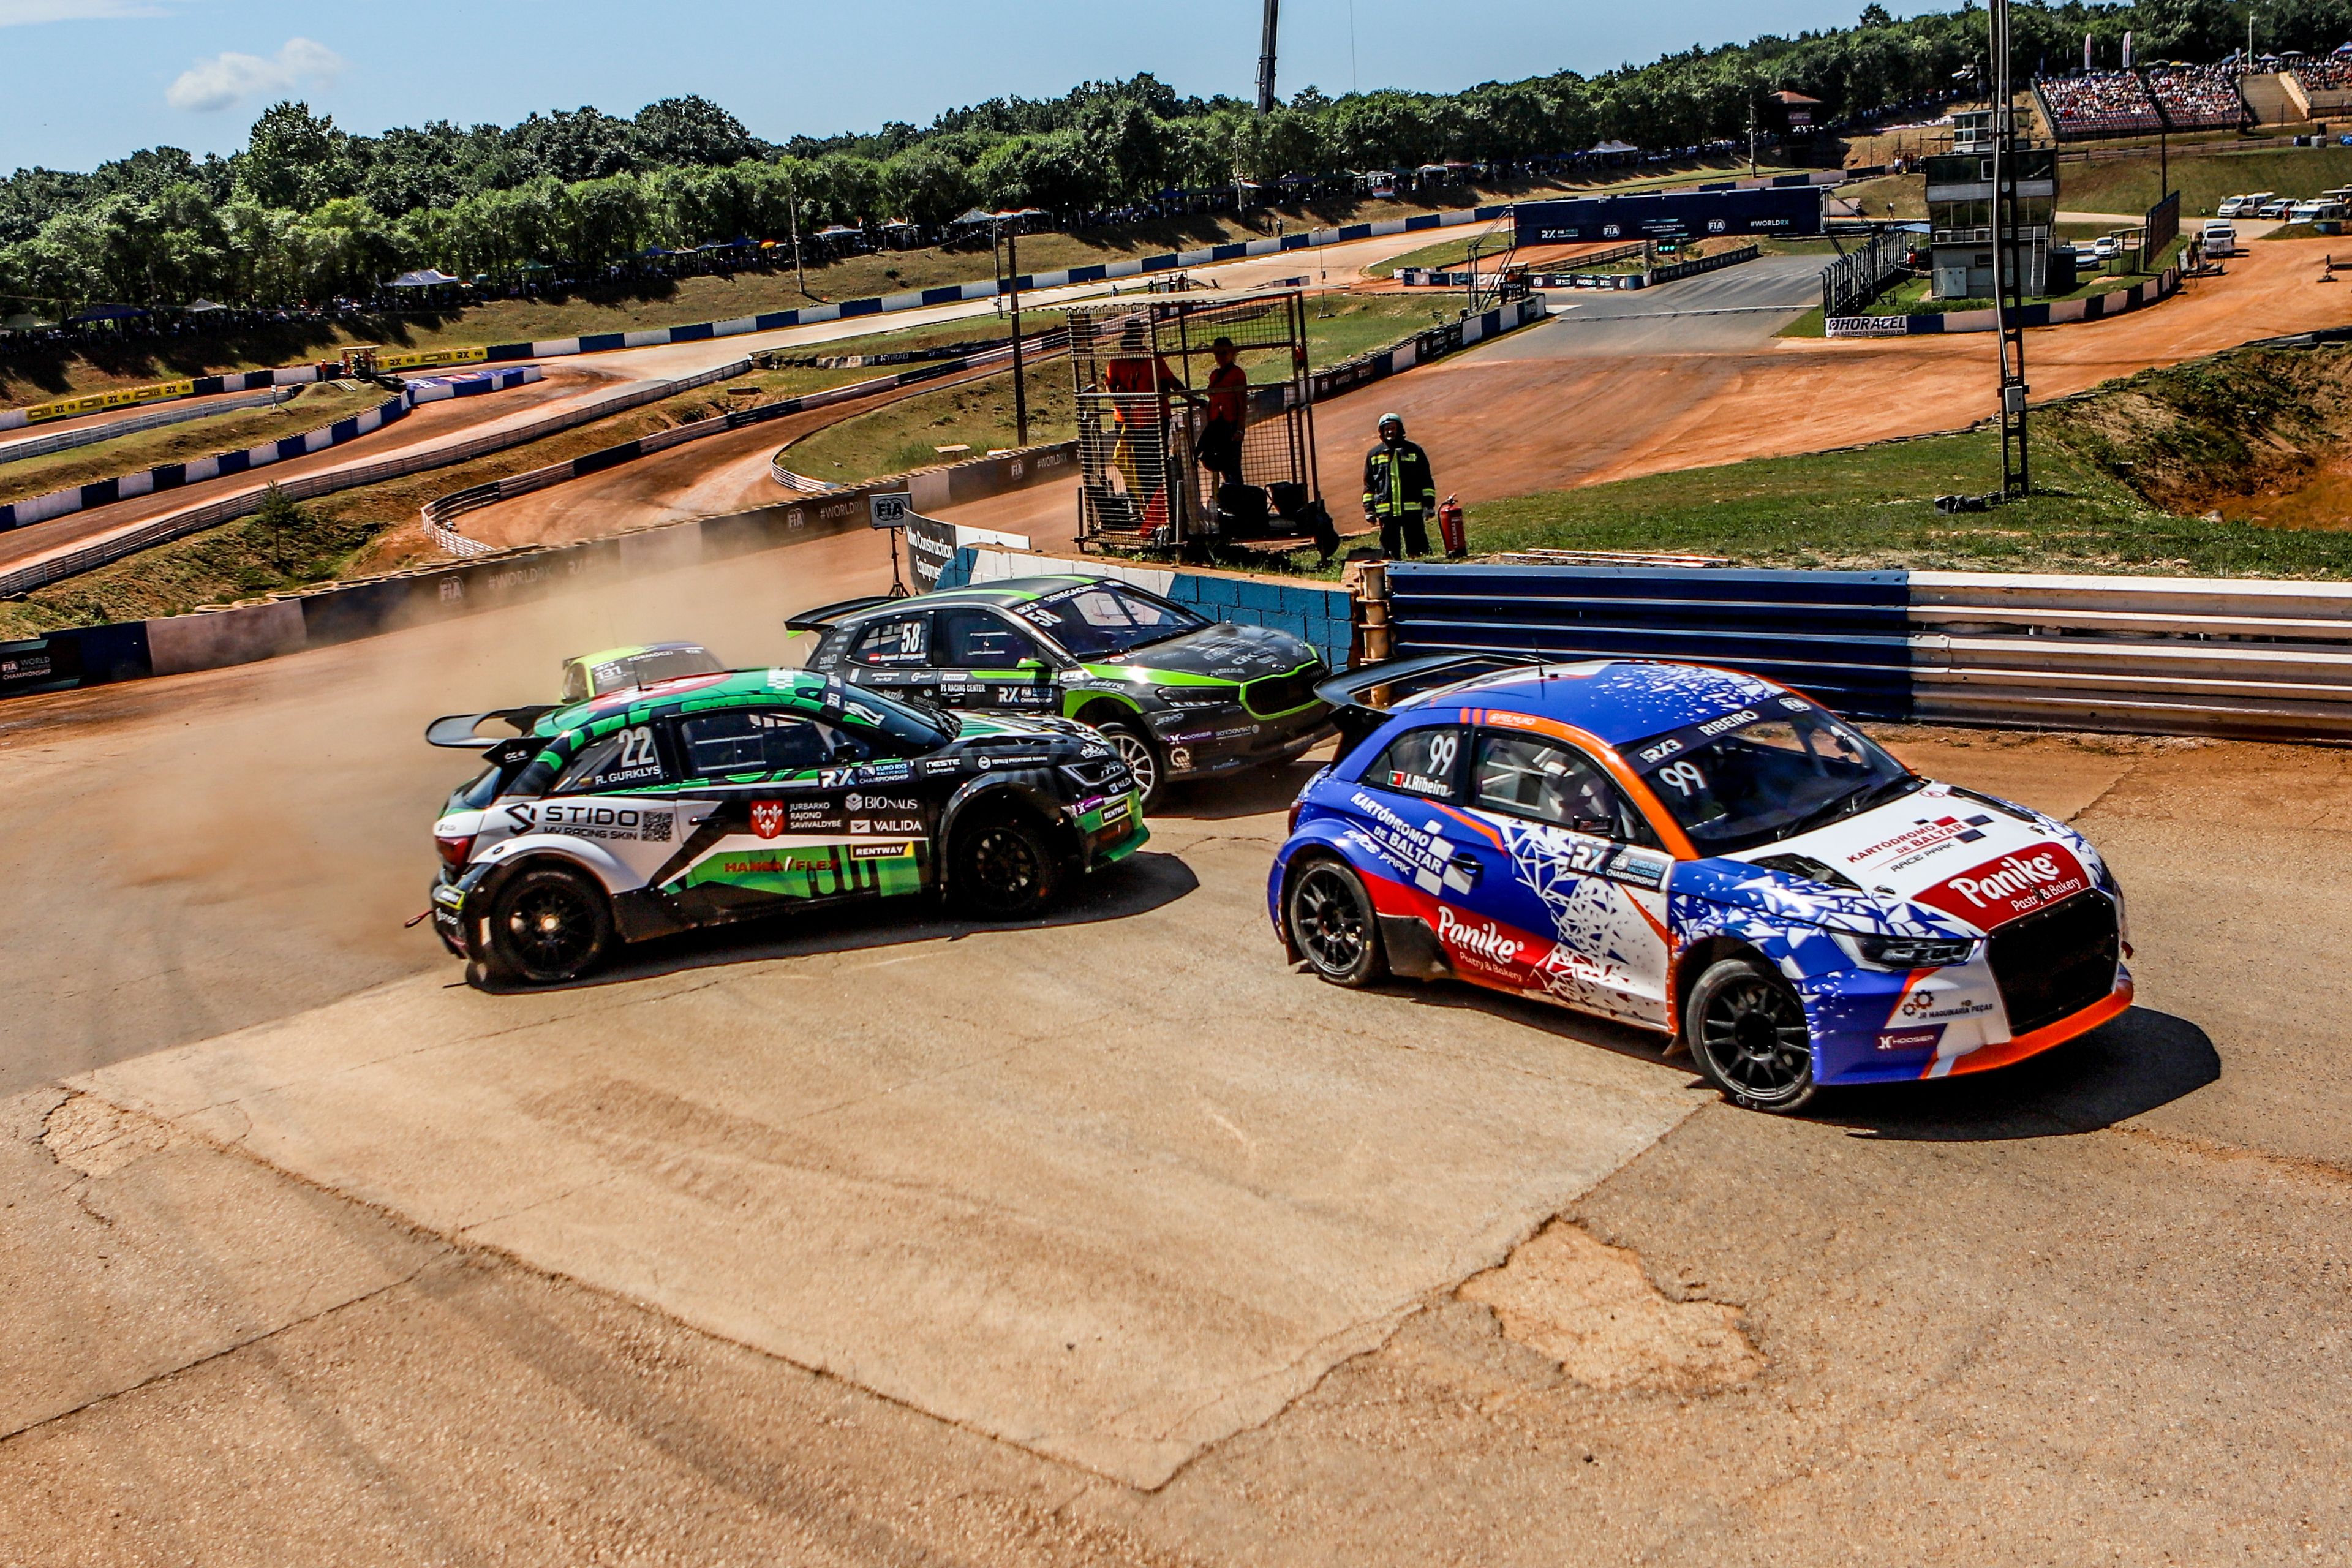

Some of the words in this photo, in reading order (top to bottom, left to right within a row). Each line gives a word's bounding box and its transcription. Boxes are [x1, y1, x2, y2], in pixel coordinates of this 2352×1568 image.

[1604, 227, 1619, 236] FIA
[1708, 221, 1723, 230] FIA
[1542, 230, 1556, 238] RX
[165, 385, 178, 394] RX
[107, 395, 118, 404] RX
[54, 404, 66, 413] RX
[1037, 453, 1068, 469] #WORLDRX
[1011, 464, 1023, 477] FIA
[820, 501, 864, 520] #WORLDRX
[876, 503, 905, 518] FIA
[788, 512, 804, 529] FIA
[916, 530, 954, 559] Construction
[488, 565, 552, 589] #WORLDRX
[440, 582, 461, 601] FIA
[1025, 608, 1063, 628] 58
[900, 622, 921, 654] 58
[2, 661, 18, 673] FIA
[20, 657, 50, 666] WORLD
[3, 668, 51, 680] CHAMPIONSHIP
[595, 665, 622, 680] 131
[940, 684, 947, 693] PS
[948, 684, 966, 693] RACING
[966, 684, 986, 693] CENTER
[998, 687, 1019, 703] RX
[1783, 699, 1809, 711] FIA
[1698, 710, 1759, 736] RIBEIRO
[1180, 731, 1212, 741] HOOSIER
[618, 726, 655, 768] 22
[1645, 739, 1684, 762] RX3
[925, 758, 961, 768] NESTE
[1427, 734, 1457, 777] 99
[595, 775, 607, 785] R.
[608, 766, 662, 783] GURKLYS
[821, 768, 856, 788] RX
[859, 774, 909, 785] CHAMPIONSHIP
[1659, 761, 1706, 797] 99
[1402, 774, 1449, 797] J.Ribeiro
[790, 802, 831, 812] JURBARKO
[1104, 804, 1127, 820] RENTWAY
[545, 806, 639, 827] STIDO
[790, 811, 822, 820] RAJONO
[1350, 791, 1431, 847] KARTÓDROMO
[565, 827, 608, 838] RACING
[609, 830, 638, 840] SKIN
[873, 820, 922, 832] VAILIDA
[1847, 824, 1937, 863] KARTÓDROMO
[1895, 845, 1912, 854] DE
[1910, 823, 1967, 847] BALTAR
[856, 846, 903, 856] RENTWAY
[1343, 829, 1380, 854] RACE
[1378, 851, 1411, 876] PARK
[1373, 825, 1386, 840] DE
[1388, 833, 1444, 874] BALTAR
[1890, 854, 1924, 873] RACE
[1923, 842, 1956, 858] PARK
[1627, 865, 1660, 878] RALLYCROSS
[1629, 858, 1649, 869] EURO
[1606, 869, 1658, 887] CHAMPIONSHIP
[1948, 856, 2060, 908] Panike
[2040, 888, 2052, 900] &
[2047, 877, 2082, 897] Bakery
[1438, 905, 1517, 965] Panike
[1459, 951, 1484, 970] Pastry
[1485, 960, 1493, 971] &
[1493, 963, 1523, 982] Bakery
[1971, 1003, 1993, 1013] PEÇAS
[1893, 1035, 1934, 1044] HOOSIER
